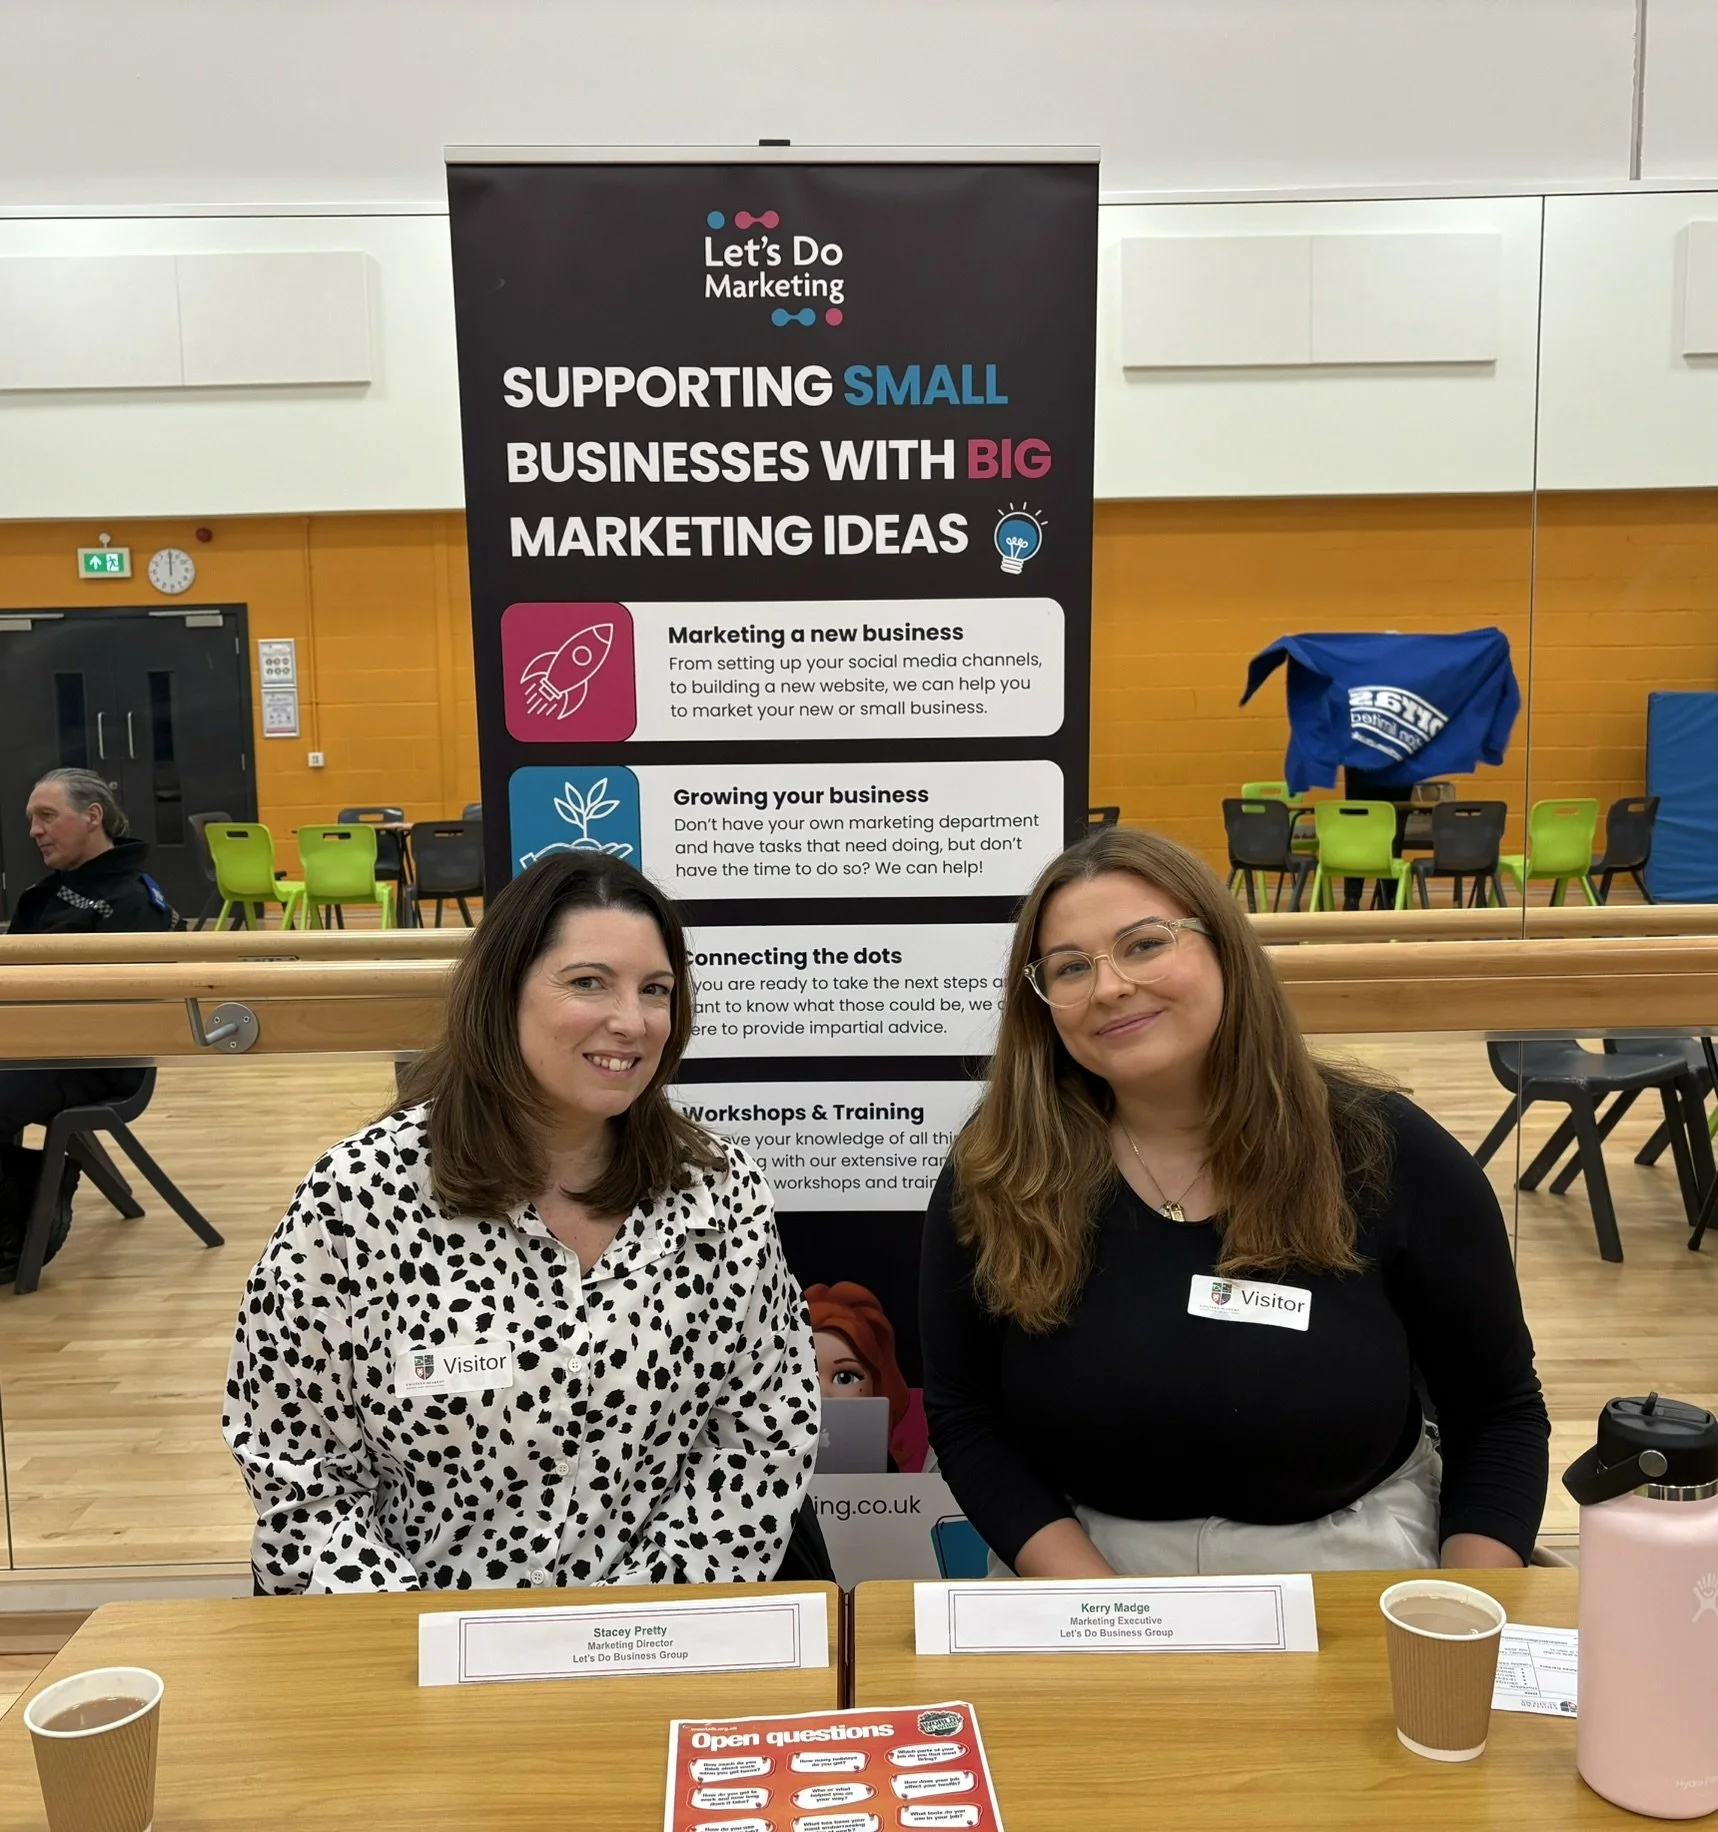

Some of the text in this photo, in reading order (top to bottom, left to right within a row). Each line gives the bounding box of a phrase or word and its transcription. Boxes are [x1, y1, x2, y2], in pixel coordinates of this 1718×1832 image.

[705, 235, 842, 266] Let's Do
[705, 271, 844, 304] Marketing
[503, 364, 1007, 408] SUPPORTING SMALL
[507, 438, 1051, 482] BUSINESSES WITH BIG
[510, 513, 968, 556] MARKETING IDEAS
[668, 622, 963, 649] Marketing a new business
[669, 652, 1041, 674] From setting up your social media channels,
[670, 676, 1030, 698] to building a new website, we can help you
[670, 700, 987, 721] to market your new or small business.
[673, 785, 928, 810] Growing your business
[674, 814, 1039, 834] Don't have your own marketing department
[675, 836, 1022, 855] and have tasks that need doing, but don't
[676, 860, 982, 878] have the time to do so? We can help!
[812, 947, 848, 964] the
[853, 947, 902, 964] dots
[728, 980, 755, 990] are
[760, 976, 807, 993] ready
[812, 977, 828, 989] to
[833, 976, 868, 989] take
[873, 975, 899, 989] the
[904, 976, 938, 988] next
[943, 976, 987, 992] steps
[725, 1000, 741, 1013] to
[746, 999, 789, 1012] know
[793, 998, 834, 1011] what
[839, 998, 884, 1011] those
[889, 998, 934, 1011] could
[940, 998, 964, 1013] be,
[968, 1000, 992, 1011] we
[721, 1023, 738, 1035] to
[743, 1020, 804, 1039] provide
[809, 1020, 882, 1038] impartial
[888, 1019, 946, 1033] advice.
[682, 1102, 923, 1127] Workshops & Training
[755, 1135, 791, 1149] your
[796, 1131, 884, 1149] knowledge
[889, 1131, 904, 1144] of
[909, 1131, 927, 1144] all
[771, 1153, 804, 1167] with
[809, 1156, 836, 1167] our
[841, 1153, 917, 1167] extensive
[774, 1176, 860, 1192] workshops
[865, 1175, 897, 1188] and
[1241, 1287, 1306, 1312] Visitor
[443, 1354, 506, 1374] Visitor
[1081, 1602, 1149, 1615] Kerry Madge
[1070, 1614, 1162, 1627] Marketing Executive
[593, 1625, 667, 1639] Stacey Pretty
[1060, 1627, 1173, 1638] Let's Do Business Group
[587, 1639, 673, 1650] Marketing Director
[572, 1650, 688, 1663] Let's Do Business Group
[691, 1723, 894, 1751] Open questions
